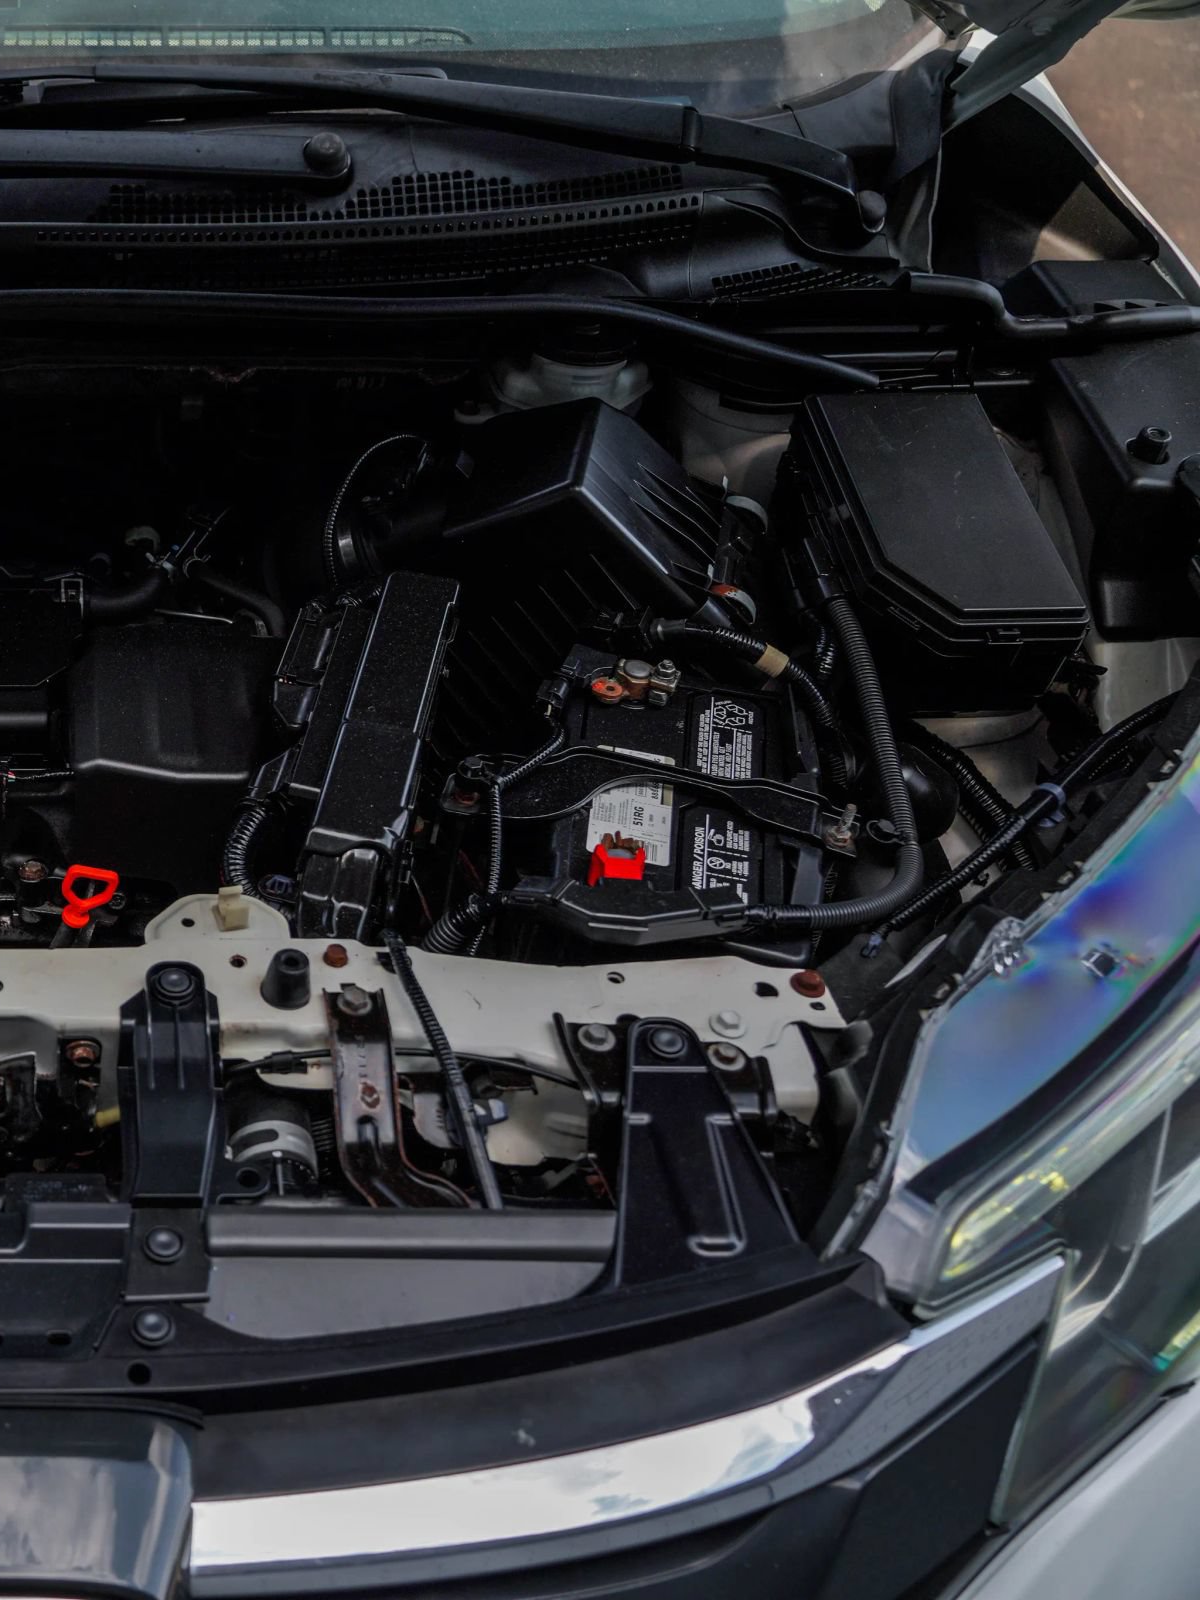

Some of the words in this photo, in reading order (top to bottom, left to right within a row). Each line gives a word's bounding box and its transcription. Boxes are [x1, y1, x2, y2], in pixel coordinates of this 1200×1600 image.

[633, 806, 644, 826] 51RG
[694, 827, 705, 854] POISON
[692, 861, 703, 890] ANGER
